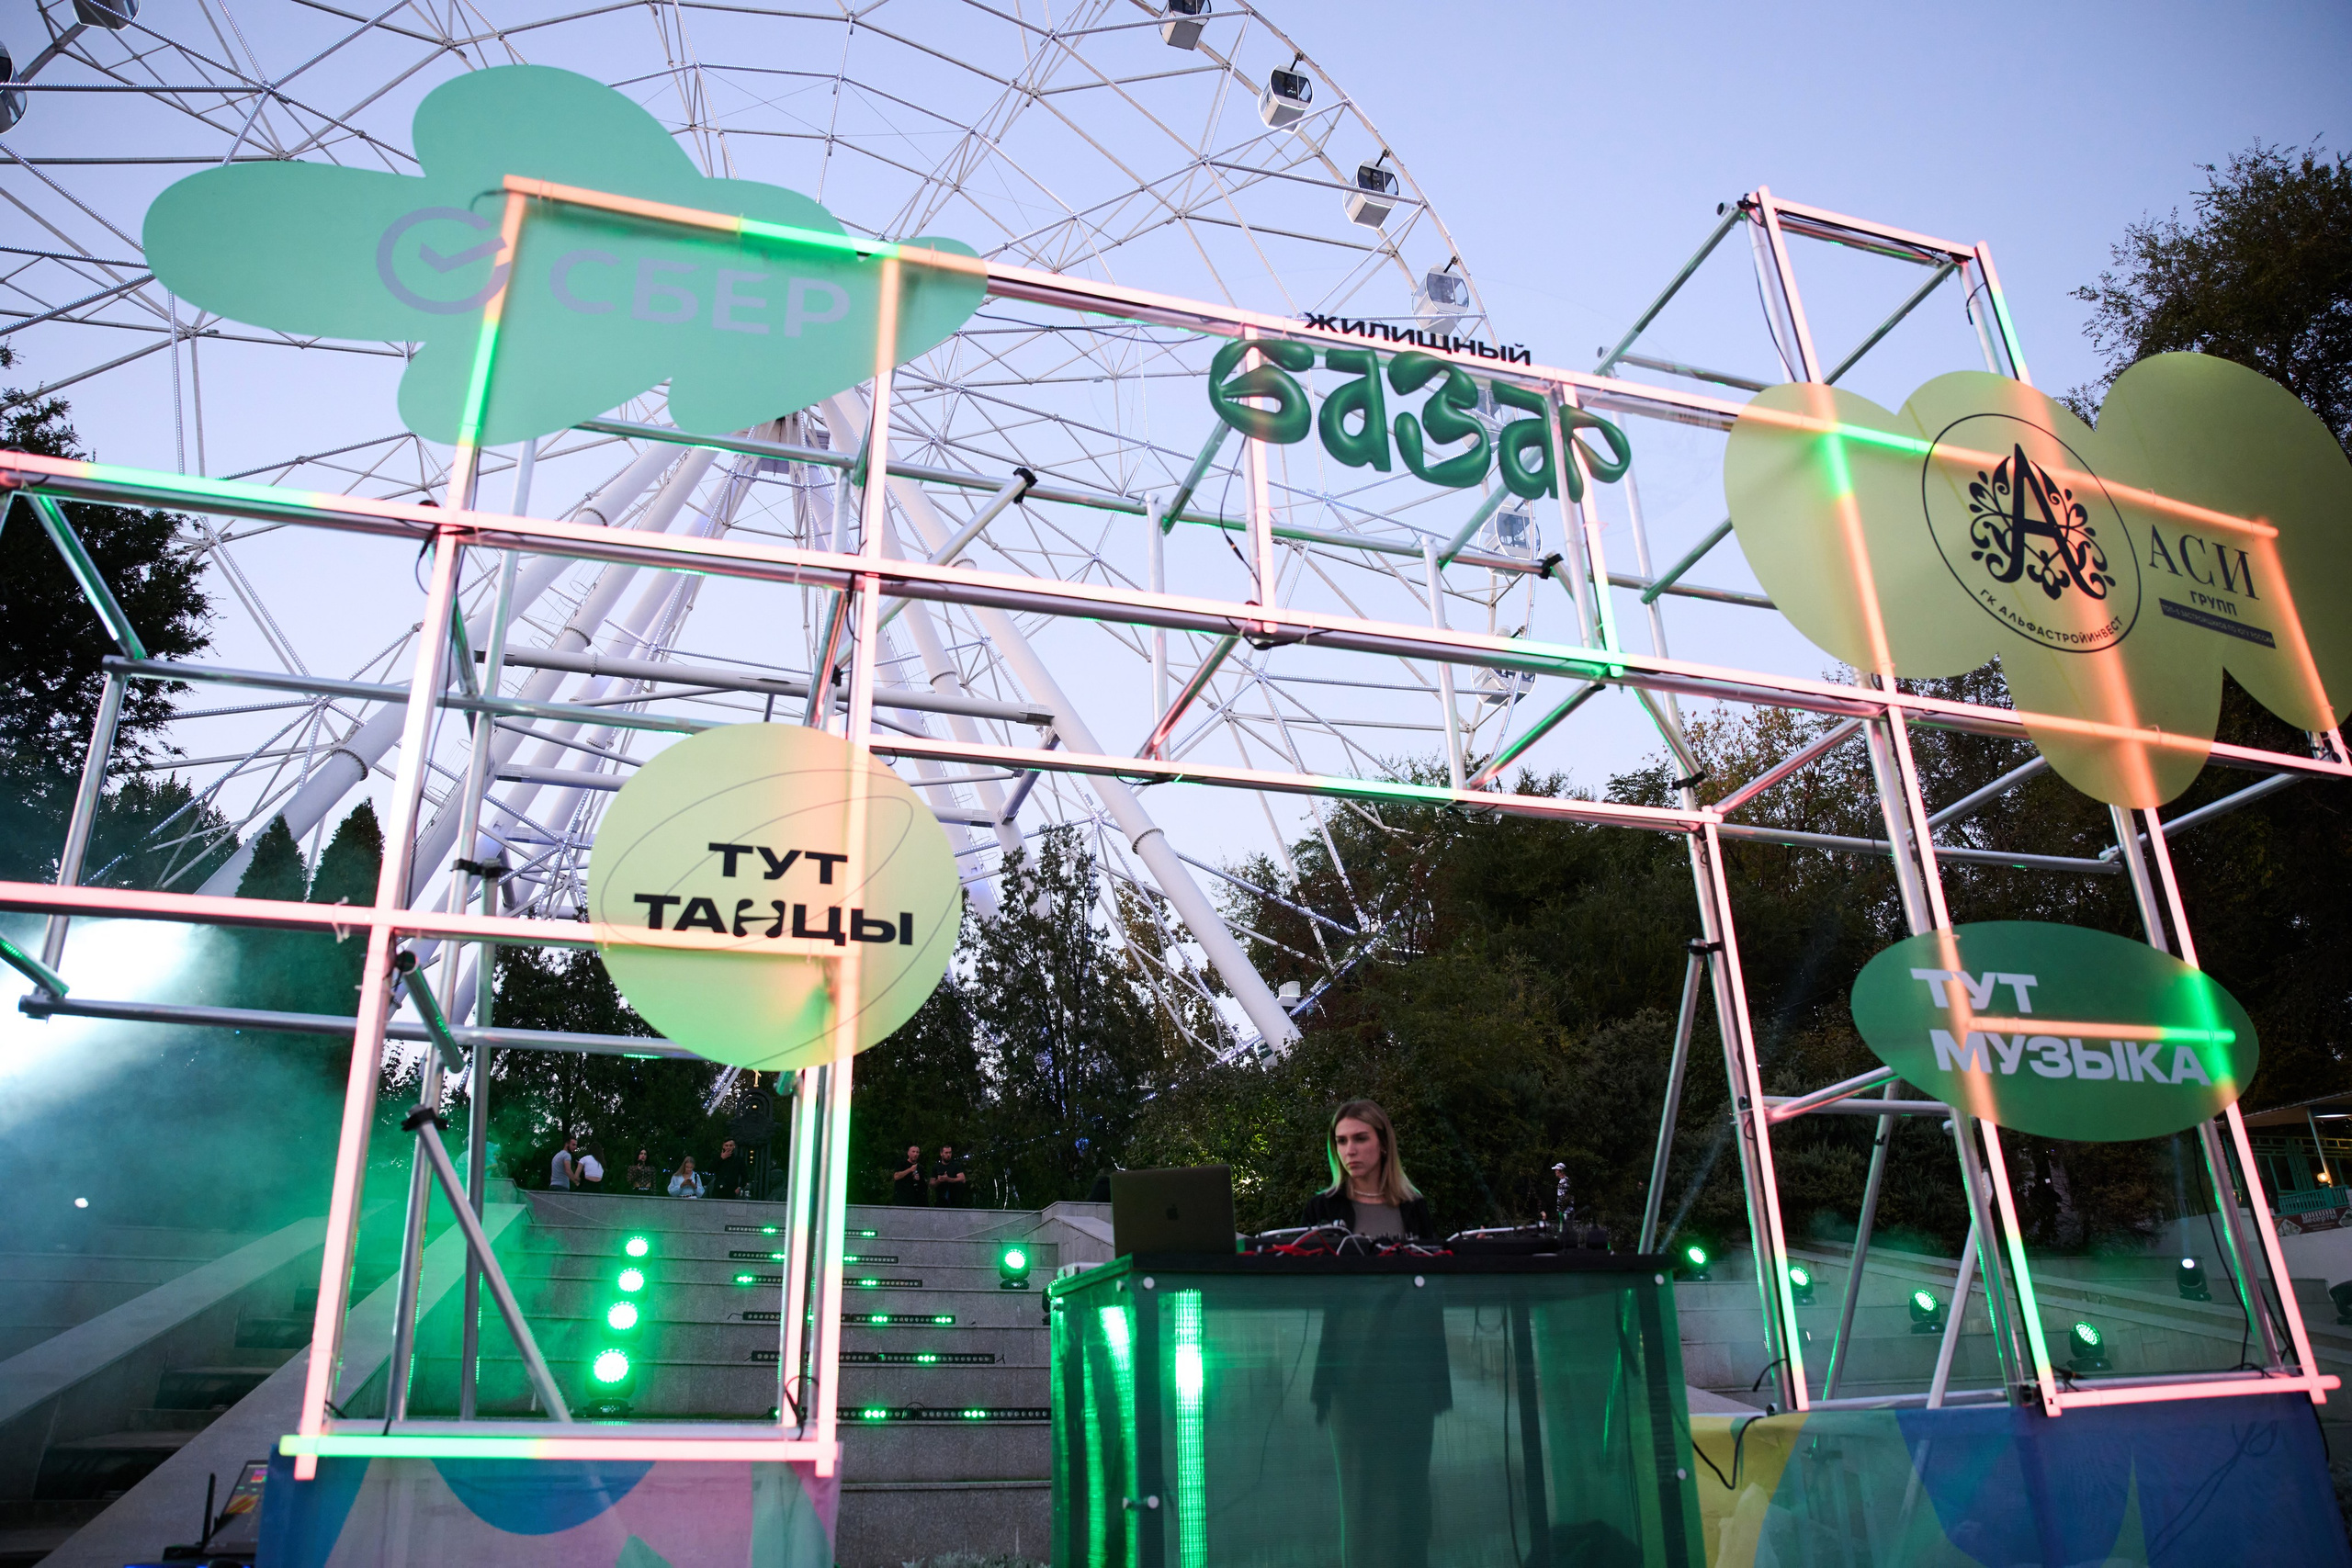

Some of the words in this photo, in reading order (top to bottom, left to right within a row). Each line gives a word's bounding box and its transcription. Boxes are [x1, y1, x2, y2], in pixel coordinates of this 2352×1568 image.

[552, 248, 851, 338] СБЕР
[2149, 525, 2260, 600] АСИ
[1980, 589, 1997, 606] ГК
[1998, 605, 2123, 644] АЛЬФАСТРОЙИНВЕСТ
[2189, 590, 2237, 617] ГРУПП
[708, 842, 848, 885] ТУТ
[634, 893, 913, 946] ТАНЦЫ
[1910, 968, 2038, 1013] ТУТ
[1929, 1029, 2211, 1086] МУЗЫКА
